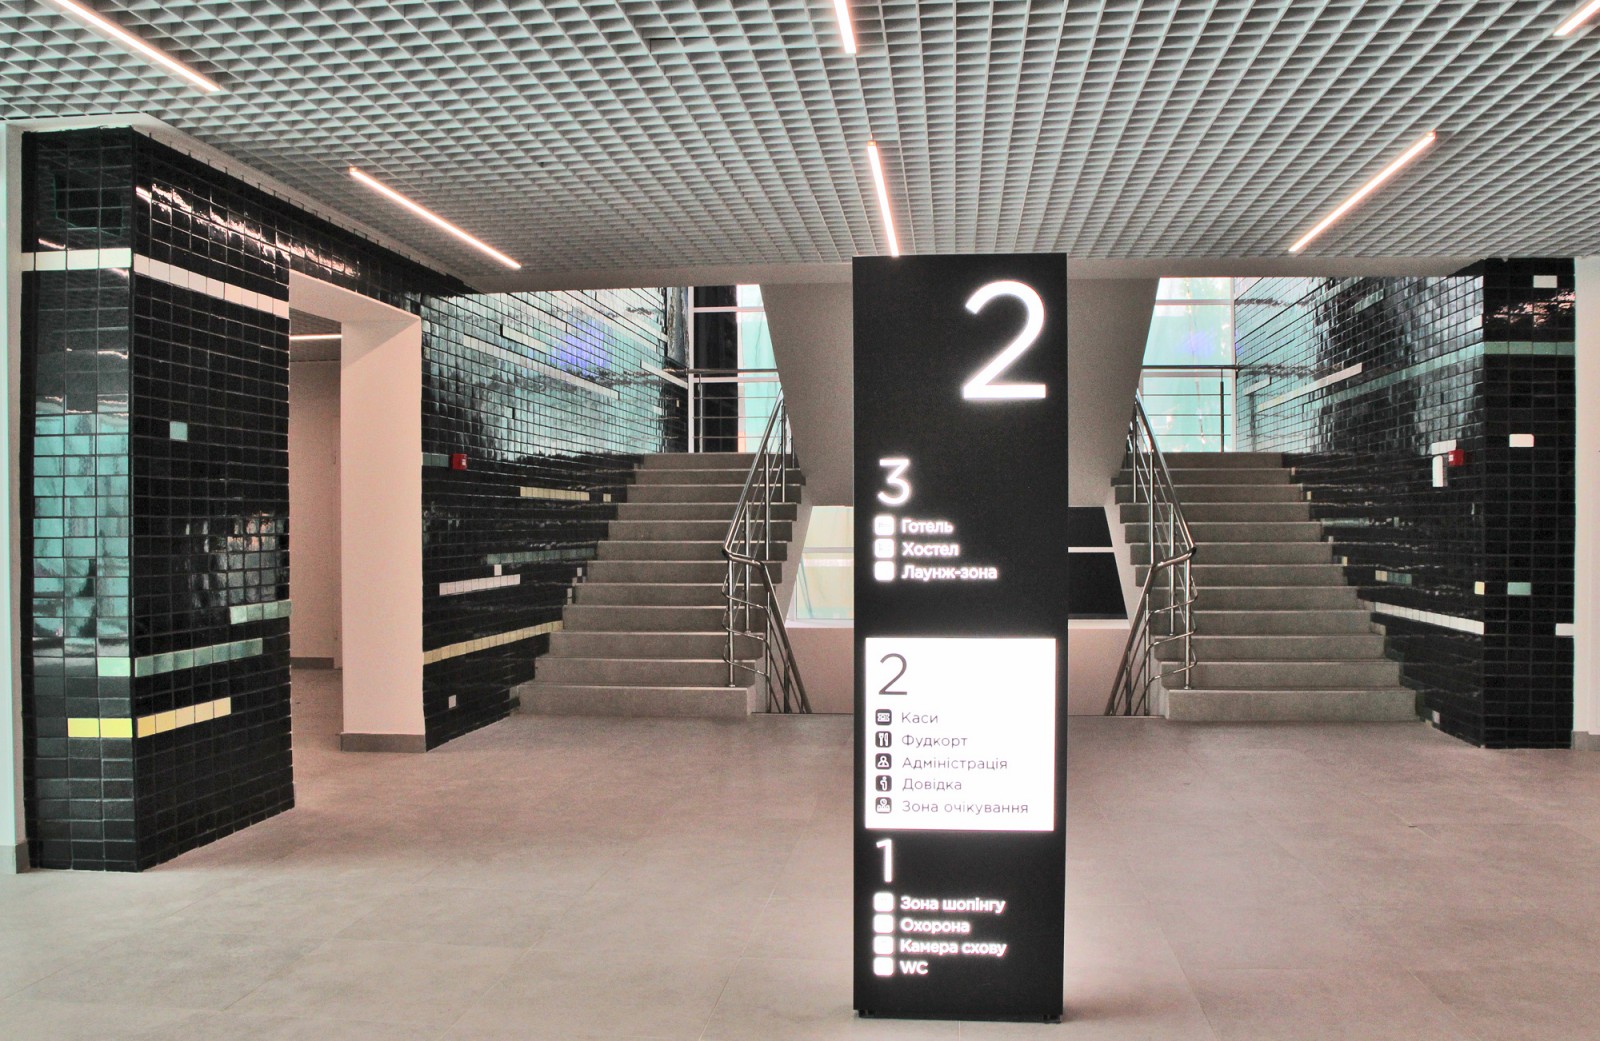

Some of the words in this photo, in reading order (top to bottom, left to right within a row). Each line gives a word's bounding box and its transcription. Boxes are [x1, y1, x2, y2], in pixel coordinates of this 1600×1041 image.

[963, 280, 1046, 400] 2
[877, 458, 912, 507] 3
[900, 518, 954, 535] Готель
[902, 541, 961, 557] Хостел
[901, 564, 998, 582] Лаунж-зона
[878, 653, 908, 696] 2
[901, 712, 938, 724] Каси
[901, 734, 968, 749] Фудкорт
[902, 757, 1008, 771] Адміністрація
[902, 778, 962, 791] Довідка
[902, 800, 939, 813] Зона
[943, 803, 1029, 815] очікування
[876, 838, 893, 882] 1
[900, 896, 939, 912] Зона
[941, 897, 1006, 914] шопінгу
[900, 917, 970, 934] Охорона
[899, 939, 959, 956] Камера
[961, 942, 1007, 957] схову
[899, 960, 928, 975] WC
